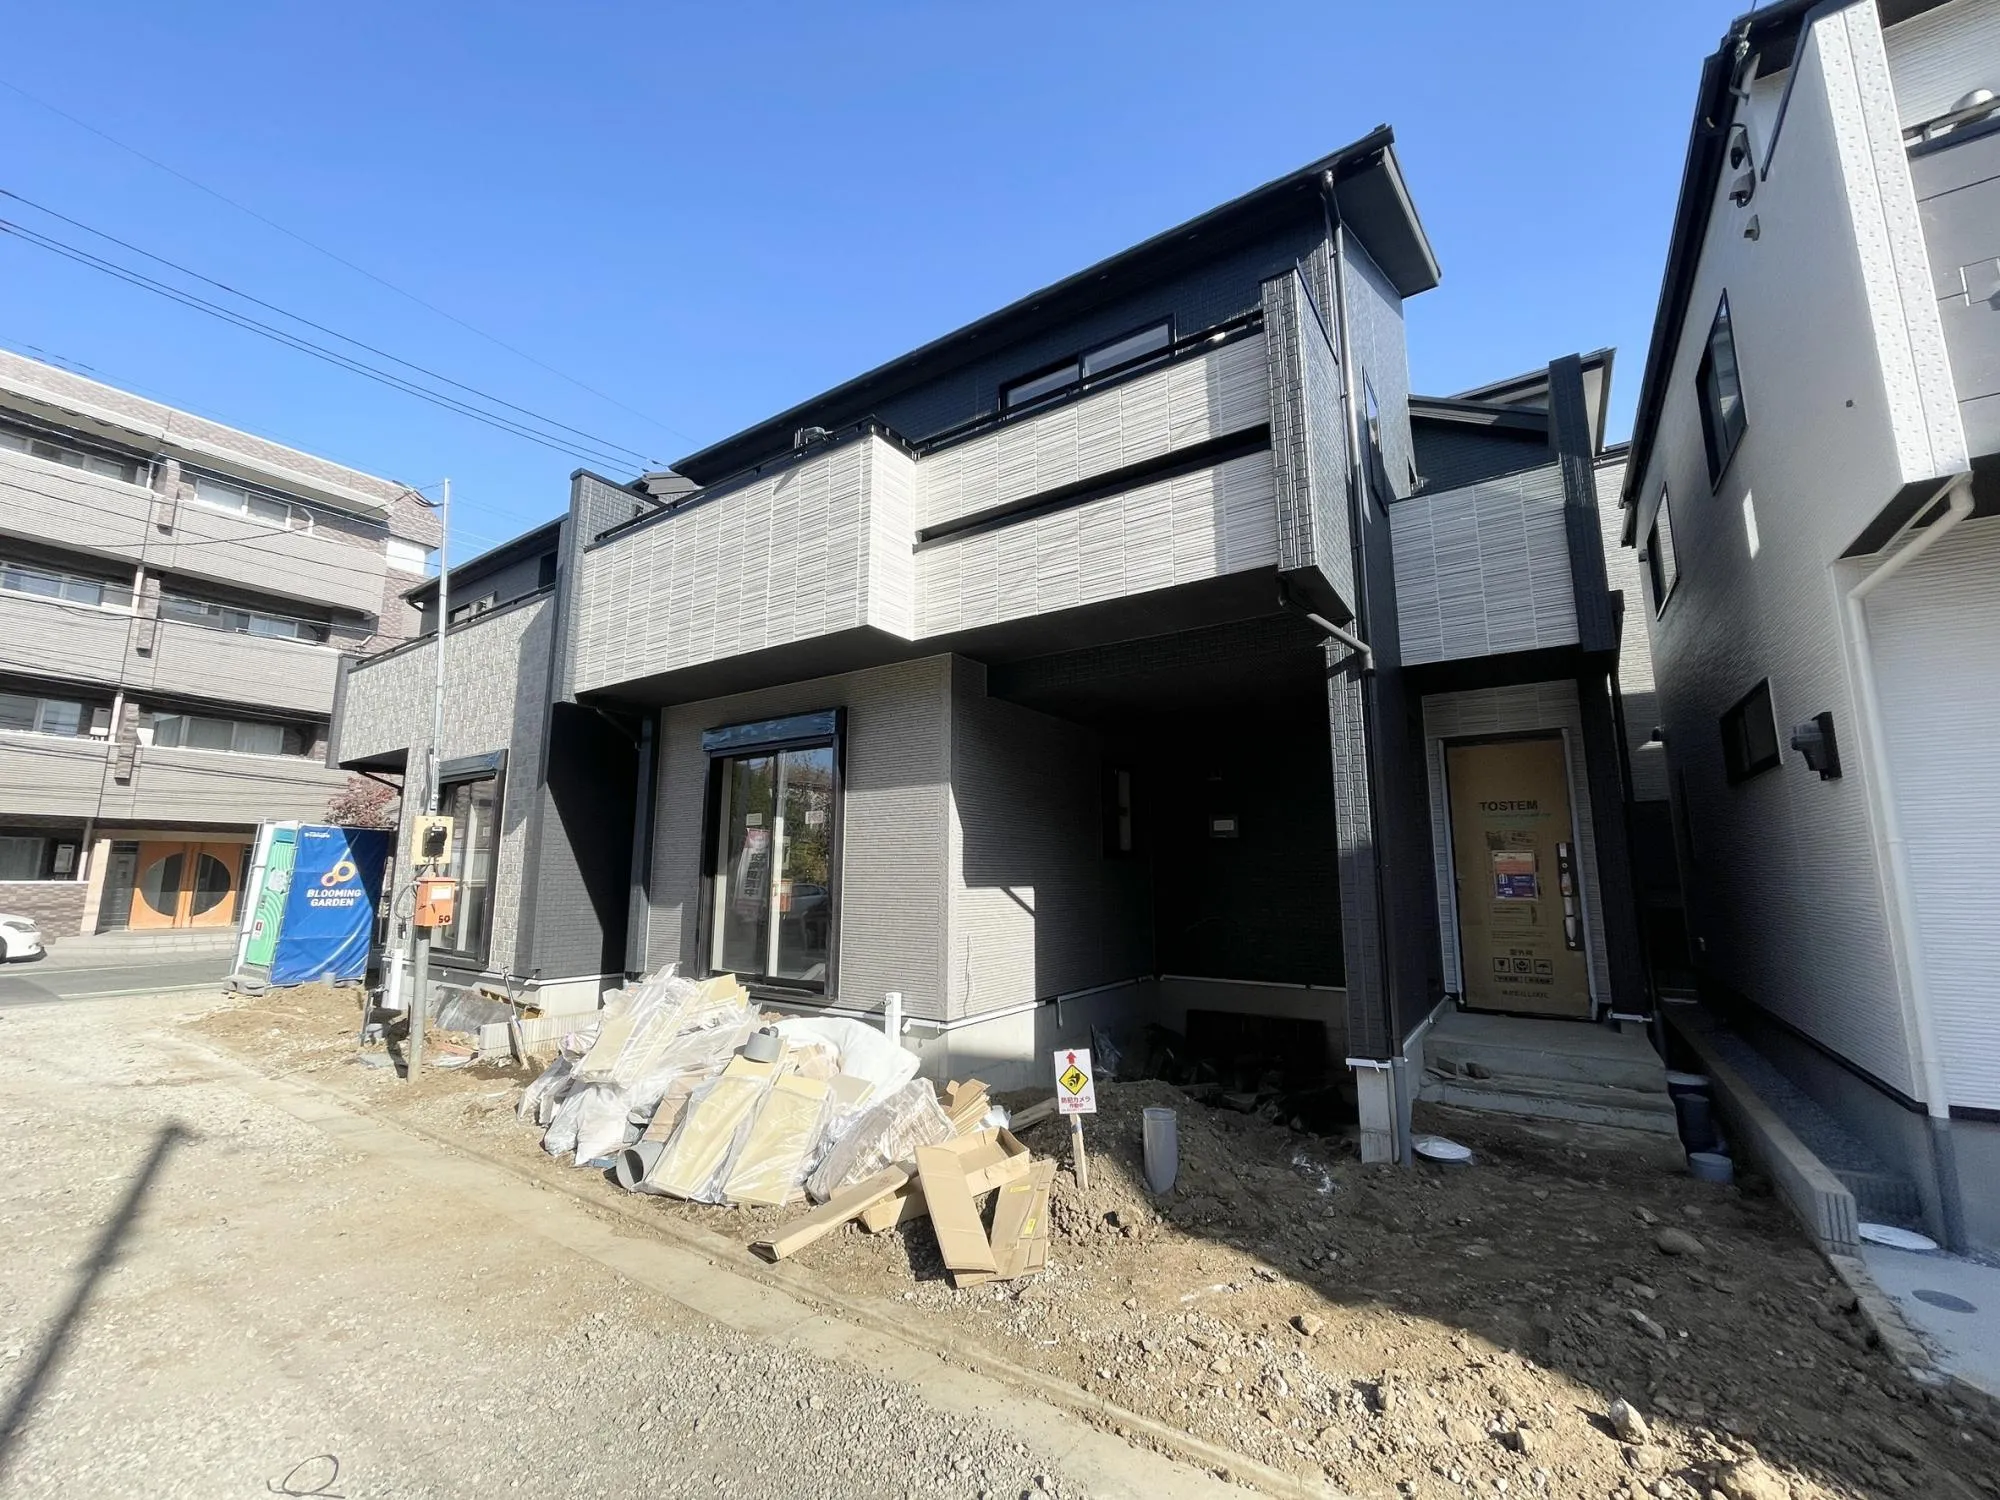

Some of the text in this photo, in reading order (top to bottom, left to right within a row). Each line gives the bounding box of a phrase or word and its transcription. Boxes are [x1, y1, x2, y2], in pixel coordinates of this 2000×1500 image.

[1478, 800, 1538, 811] TOSTEM
[306, 888, 362, 898] BLOOMING
[310, 898, 354, 907] GARDEN
